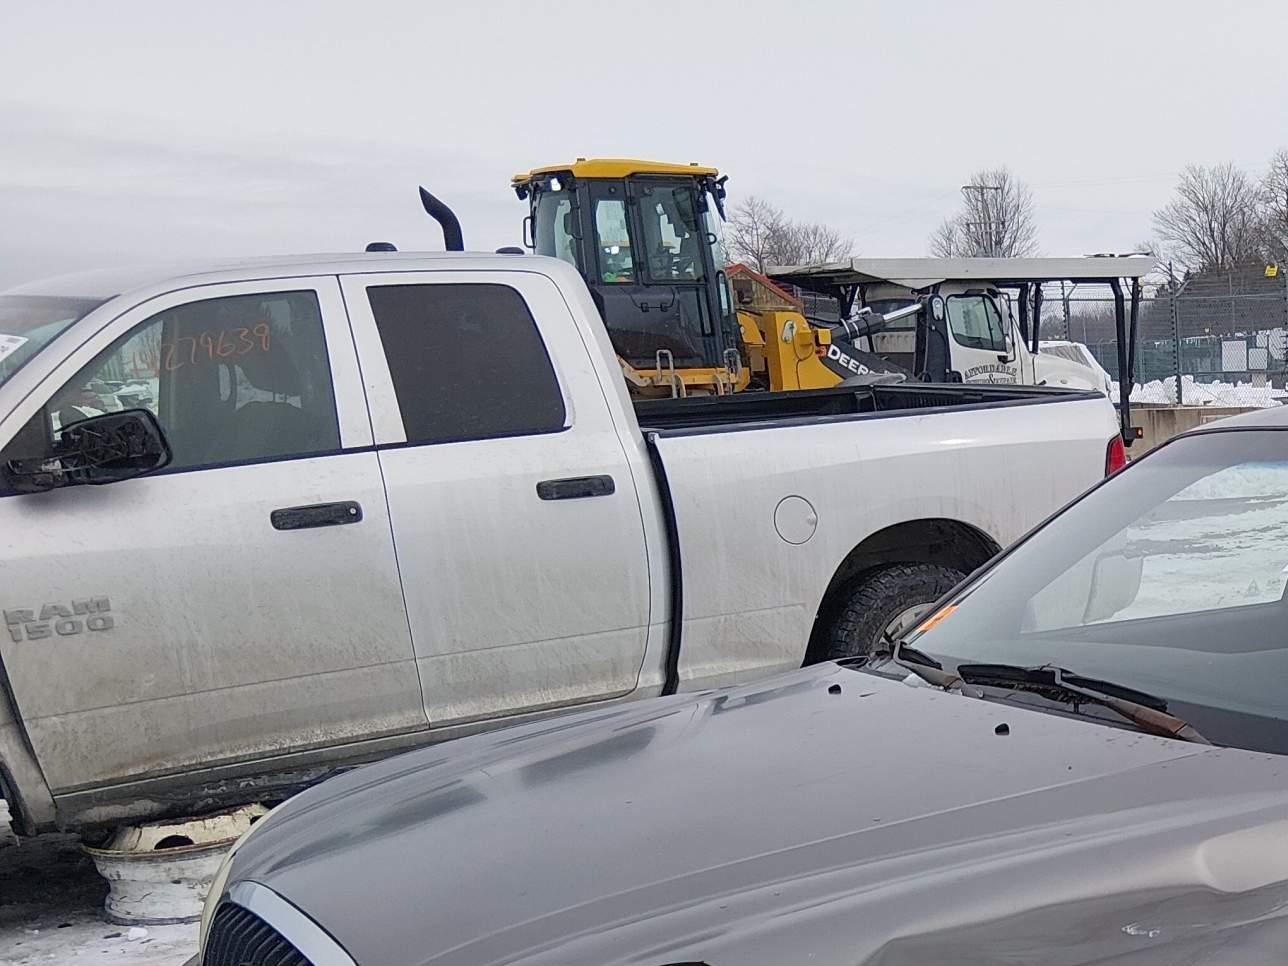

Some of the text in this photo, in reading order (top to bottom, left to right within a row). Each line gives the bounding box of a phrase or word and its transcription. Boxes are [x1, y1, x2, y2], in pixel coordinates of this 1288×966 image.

[827, 343, 876, 375] DEER
[3, 597, 112, 625] RAM
[7, 616, 115, 643] 1500
